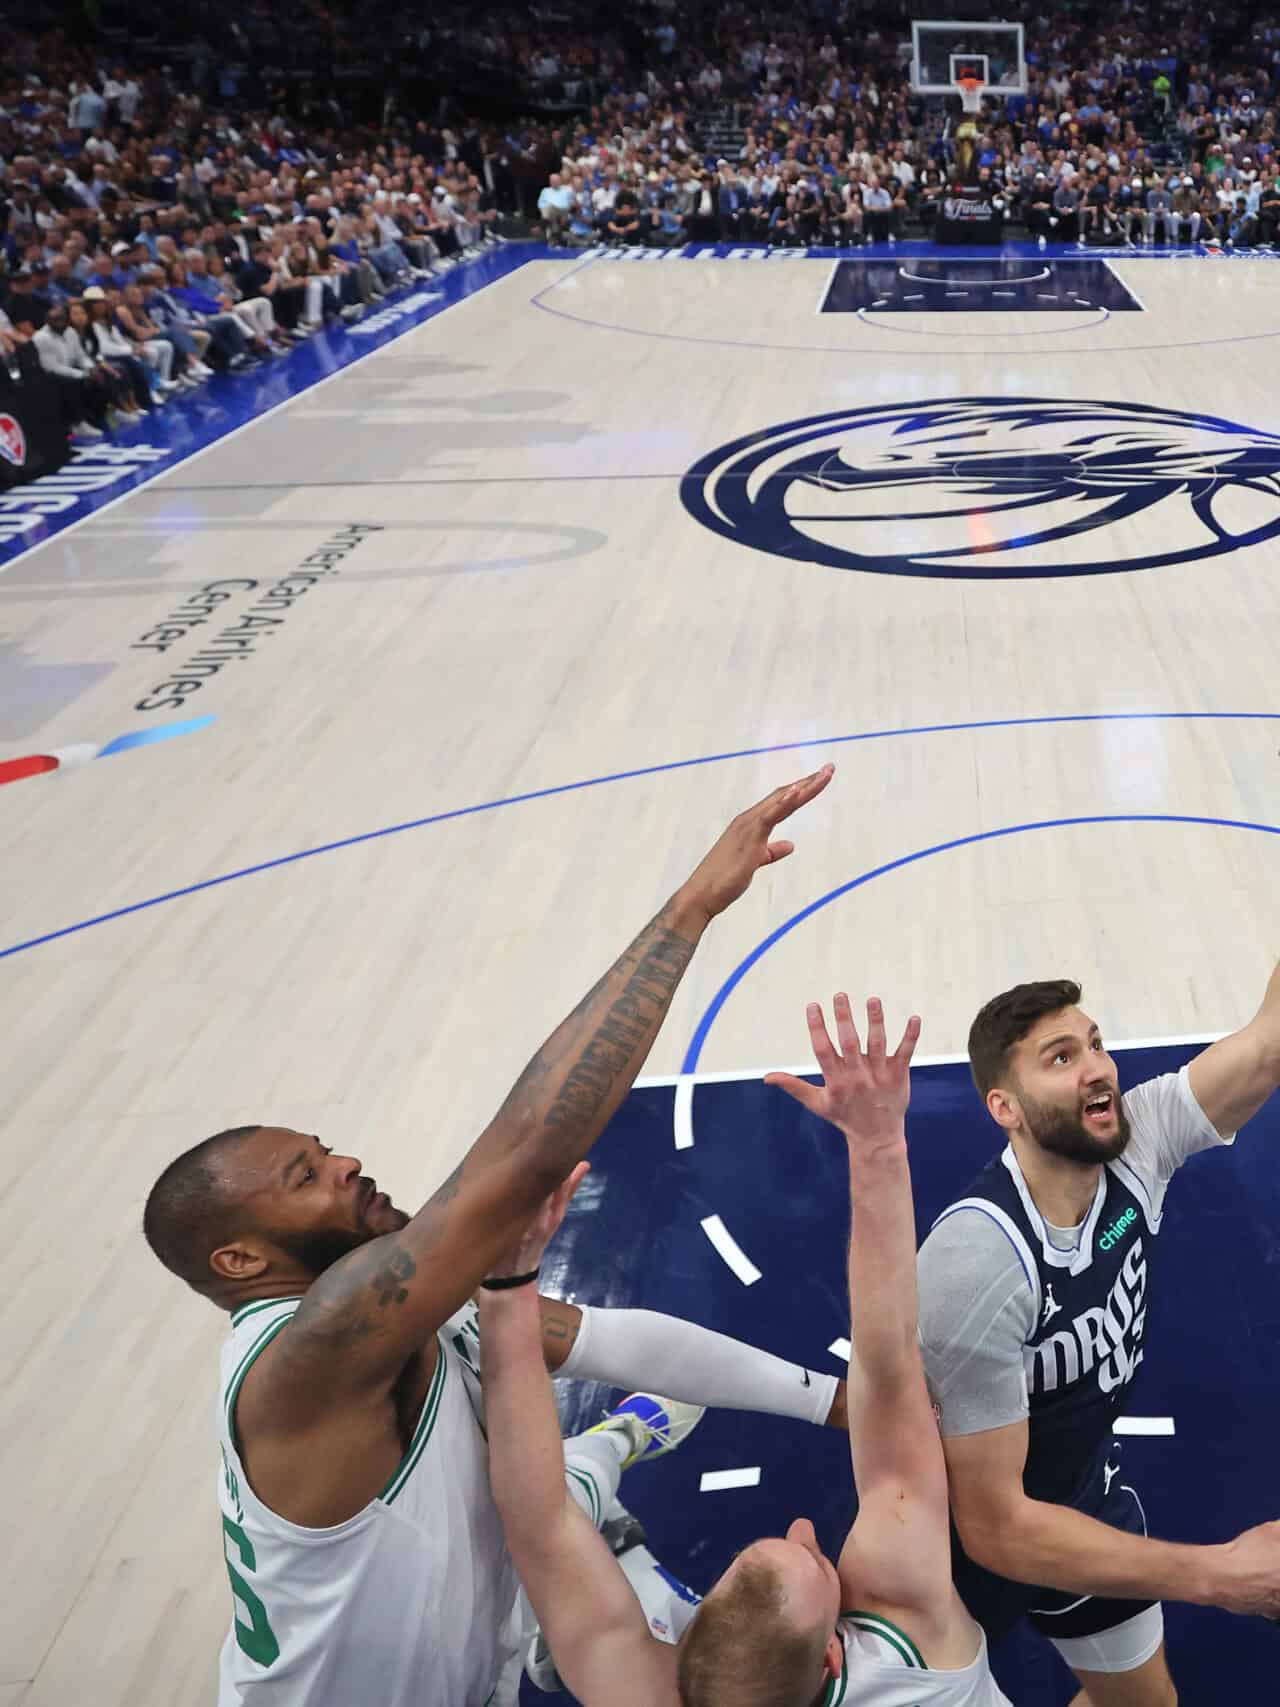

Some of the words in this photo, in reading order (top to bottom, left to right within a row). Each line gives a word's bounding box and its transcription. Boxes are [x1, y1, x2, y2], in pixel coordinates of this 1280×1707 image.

[247, 523, 385, 612] American
[130, 578, 259, 653] Center
[134, 614, 285, 712] Airlines
[1099, 1205, 1138, 1252] chime
[1024, 1236, 1147, 1394] MAVS
